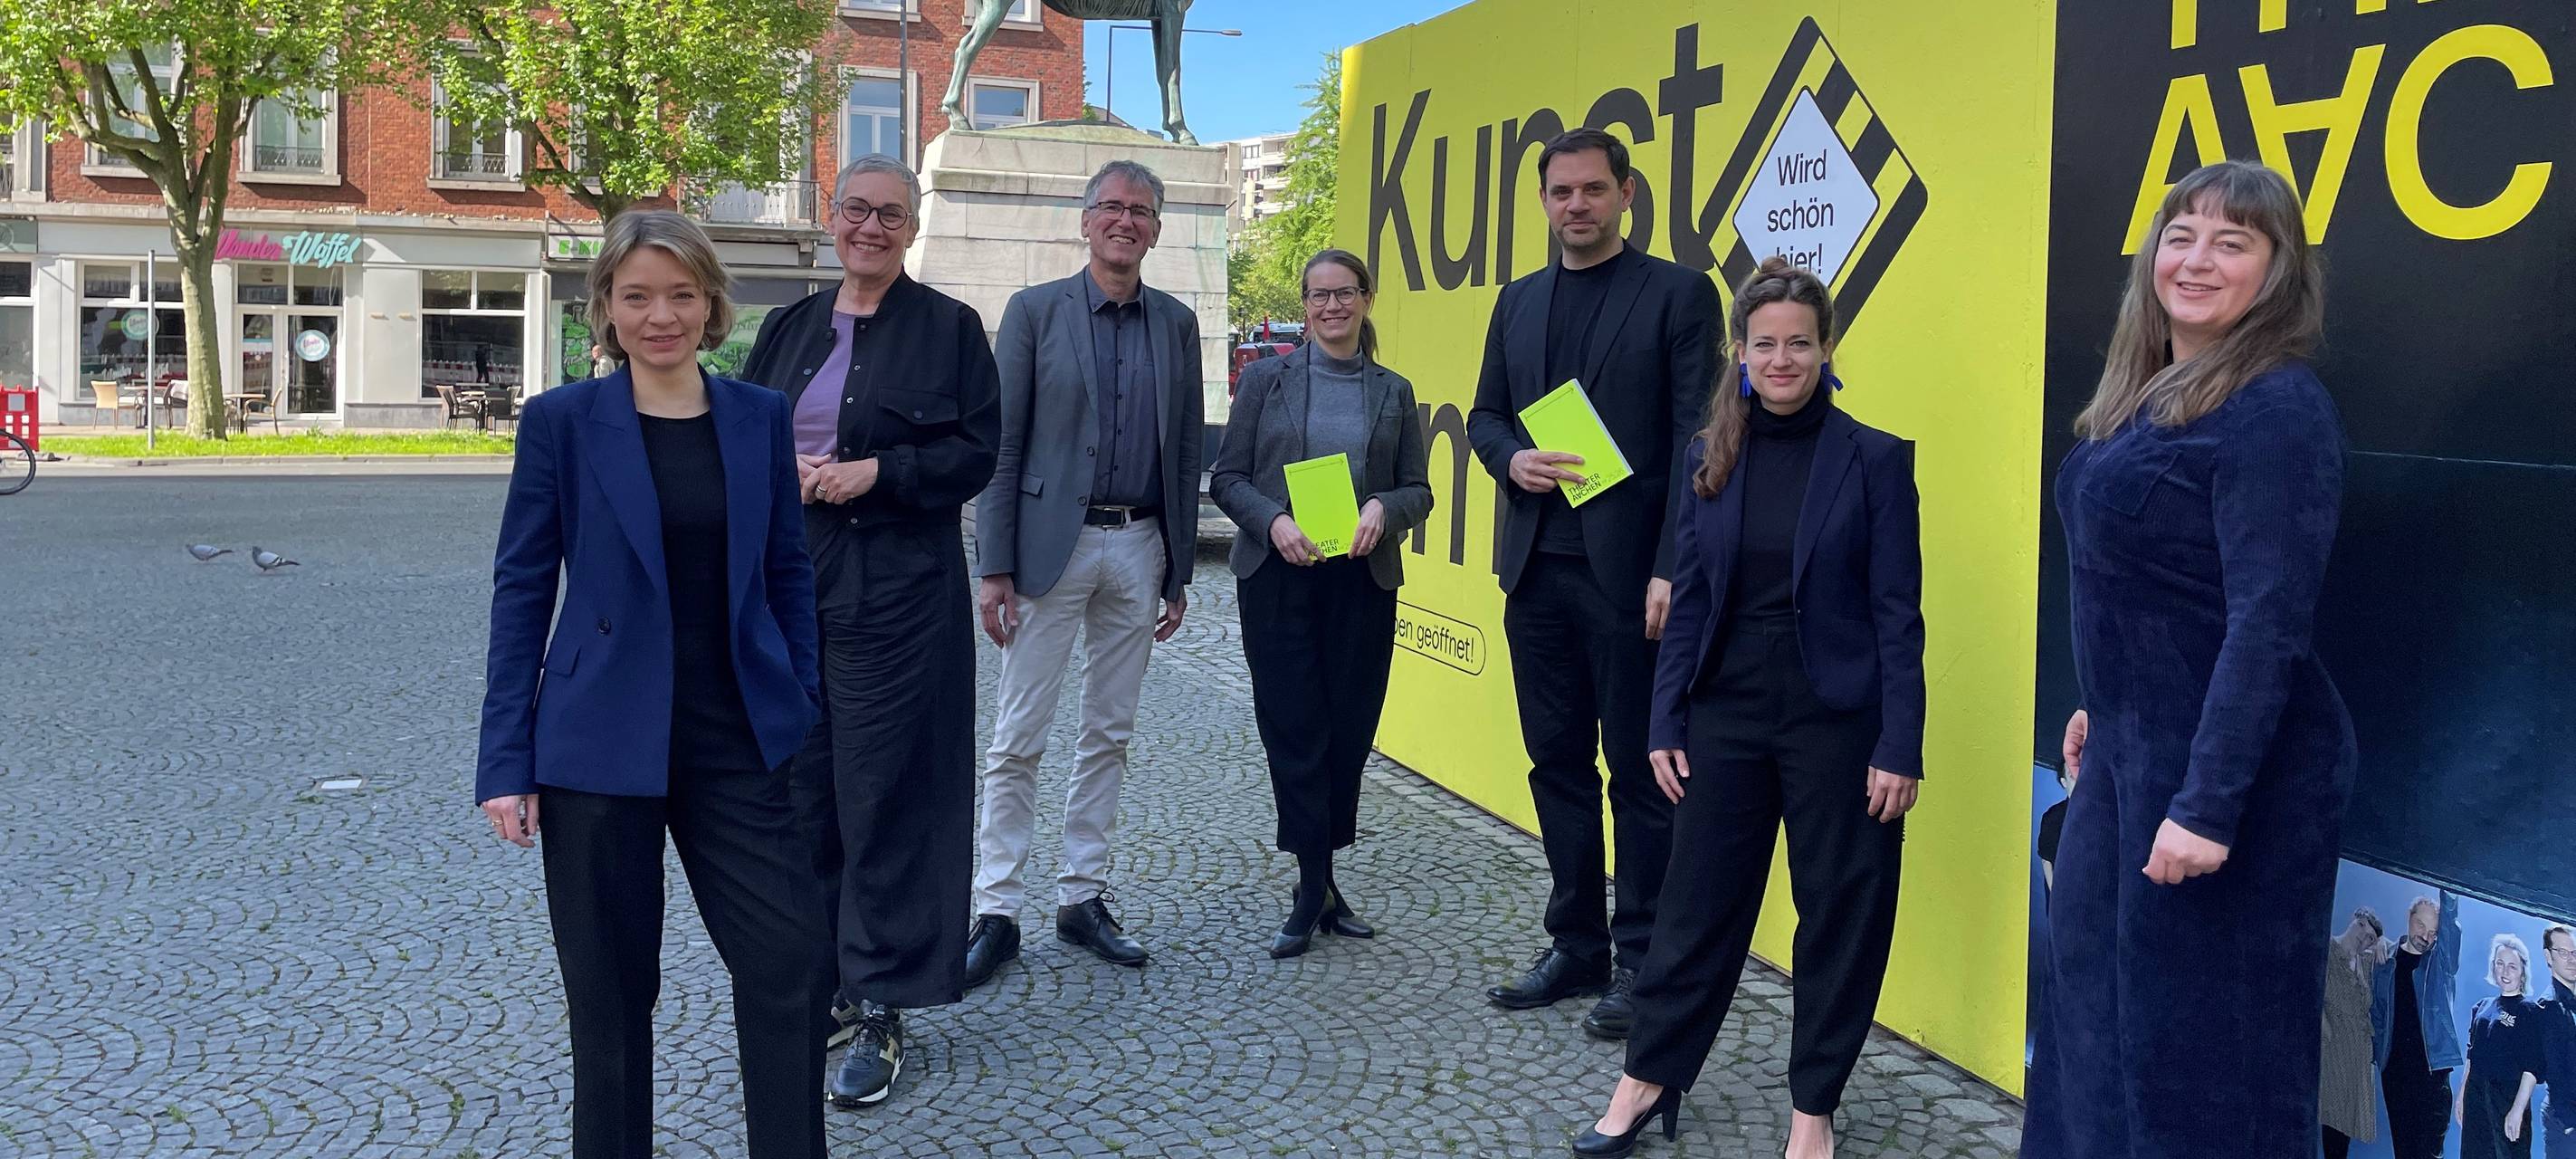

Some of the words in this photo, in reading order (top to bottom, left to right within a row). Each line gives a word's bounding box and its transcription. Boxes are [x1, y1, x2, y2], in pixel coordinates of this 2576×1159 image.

[1777, 148, 1827, 187] Wird
[1767, 196, 1834, 233] schön
[282, 231, 362, 268] Waffel
[1417, 625, 1474, 664] geöffnet!
